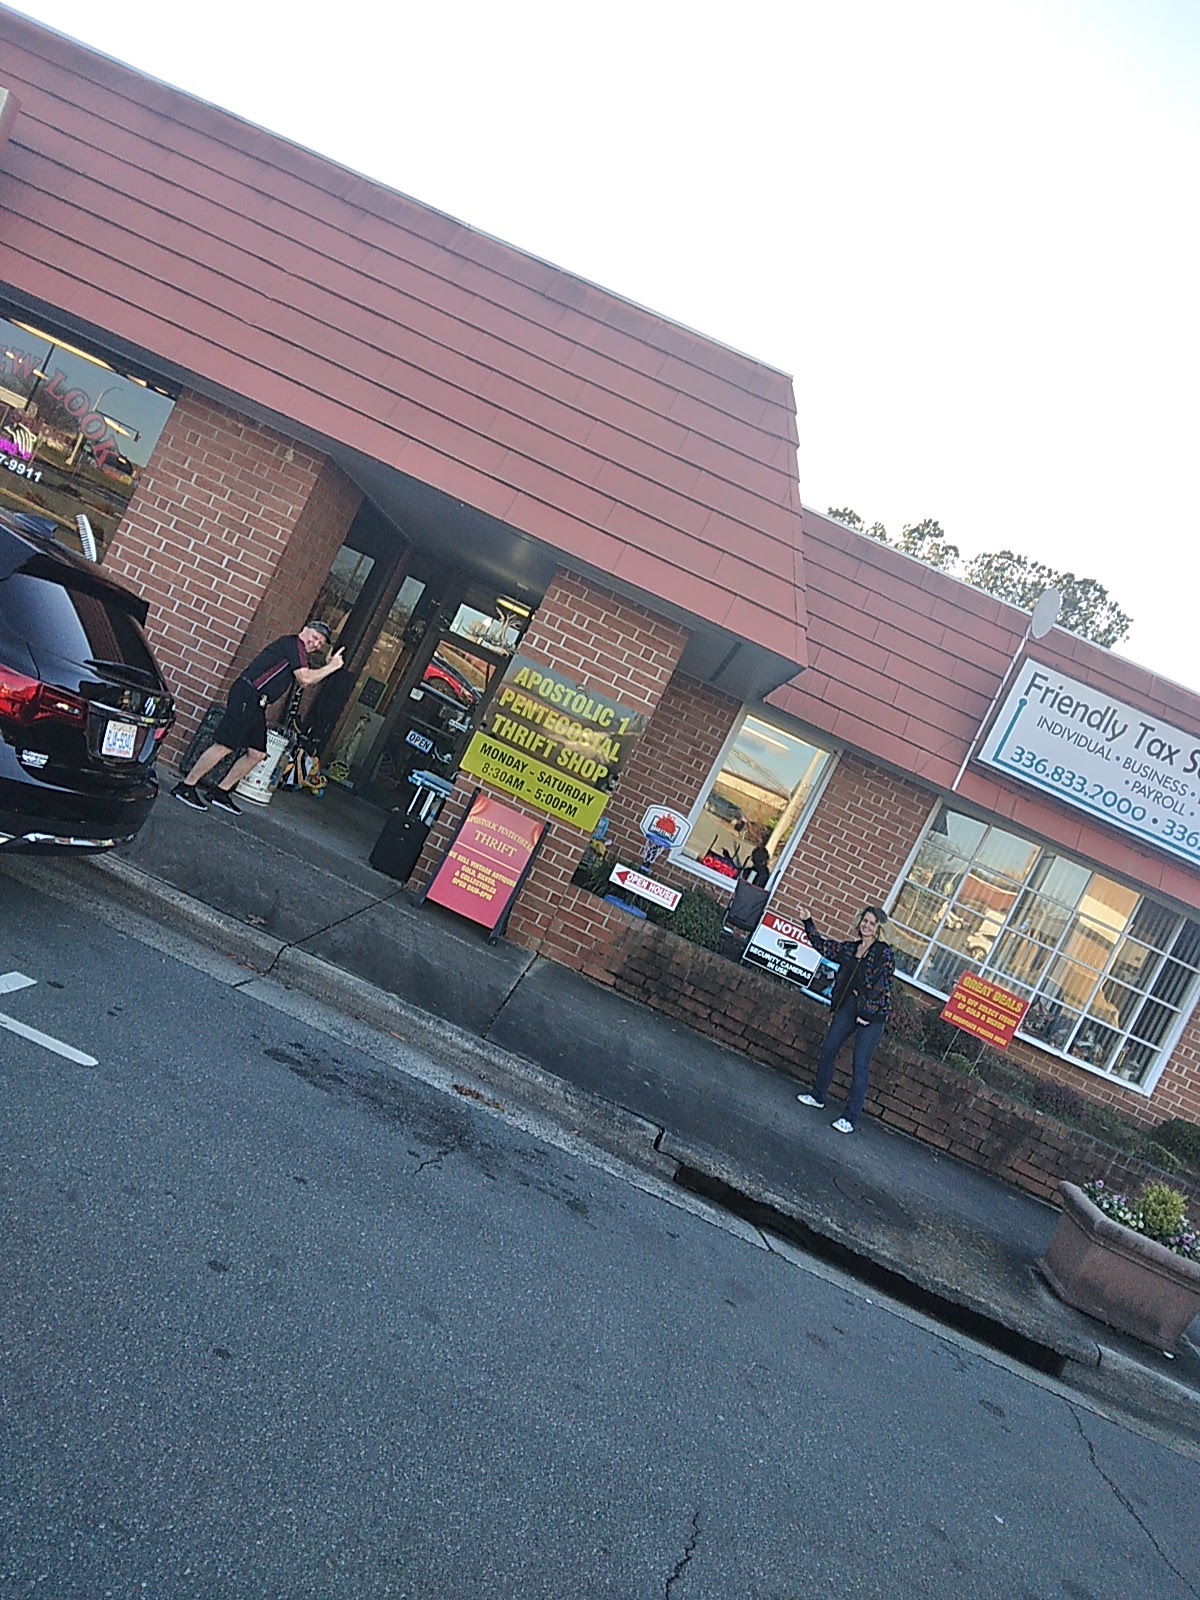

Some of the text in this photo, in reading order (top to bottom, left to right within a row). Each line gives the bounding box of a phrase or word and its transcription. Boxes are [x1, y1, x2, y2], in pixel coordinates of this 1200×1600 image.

[44, 368, 120, 467] LOOK
[514, 666, 631, 736] APOSTOLIC 1
[408, 733, 431, 750] OPEN
[498, 688, 621, 763] PENTECOSTAL
[1023, 671, 1200, 779] Friendly Tax S
[491, 713, 608, 783] THRIFT SHOP
[1036, 715, 1189, 797] INDIVIDUAL BUSINESS
[479, 742, 529, 775] MONDAY
[536, 771, 595, 807] SATURDAY
[481, 762, 525, 791] 8:30AM
[534, 788, 579, 818] 5:00PM
[1009, 745, 1147, 822] 336.833.2000
[1130, 780, 1185, 816] PAYROLL
[475, 830, 518, 857] THRIFT
[453, 878, 466, 889] OPEN
[460, 873, 497, 895] COLLECTIBLES
[626, 871, 676, 901] OPEN HOUSE
[772, 918, 812, 946] NOTIC
[749, 946, 811, 980] SECURITY CAMERAS
[766, 961, 788, 976] IN USE
[963, 977, 1023, 1013] GREAT DEALS
[966, 1007, 981, 1018] GOLD
[986, 1017, 1006, 1031] SILVER
[967, 999, 979, 1008] OFF
[979, 1003, 999, 1018] SELECT
[999, 1014, 1017, 1028] ITEMS
